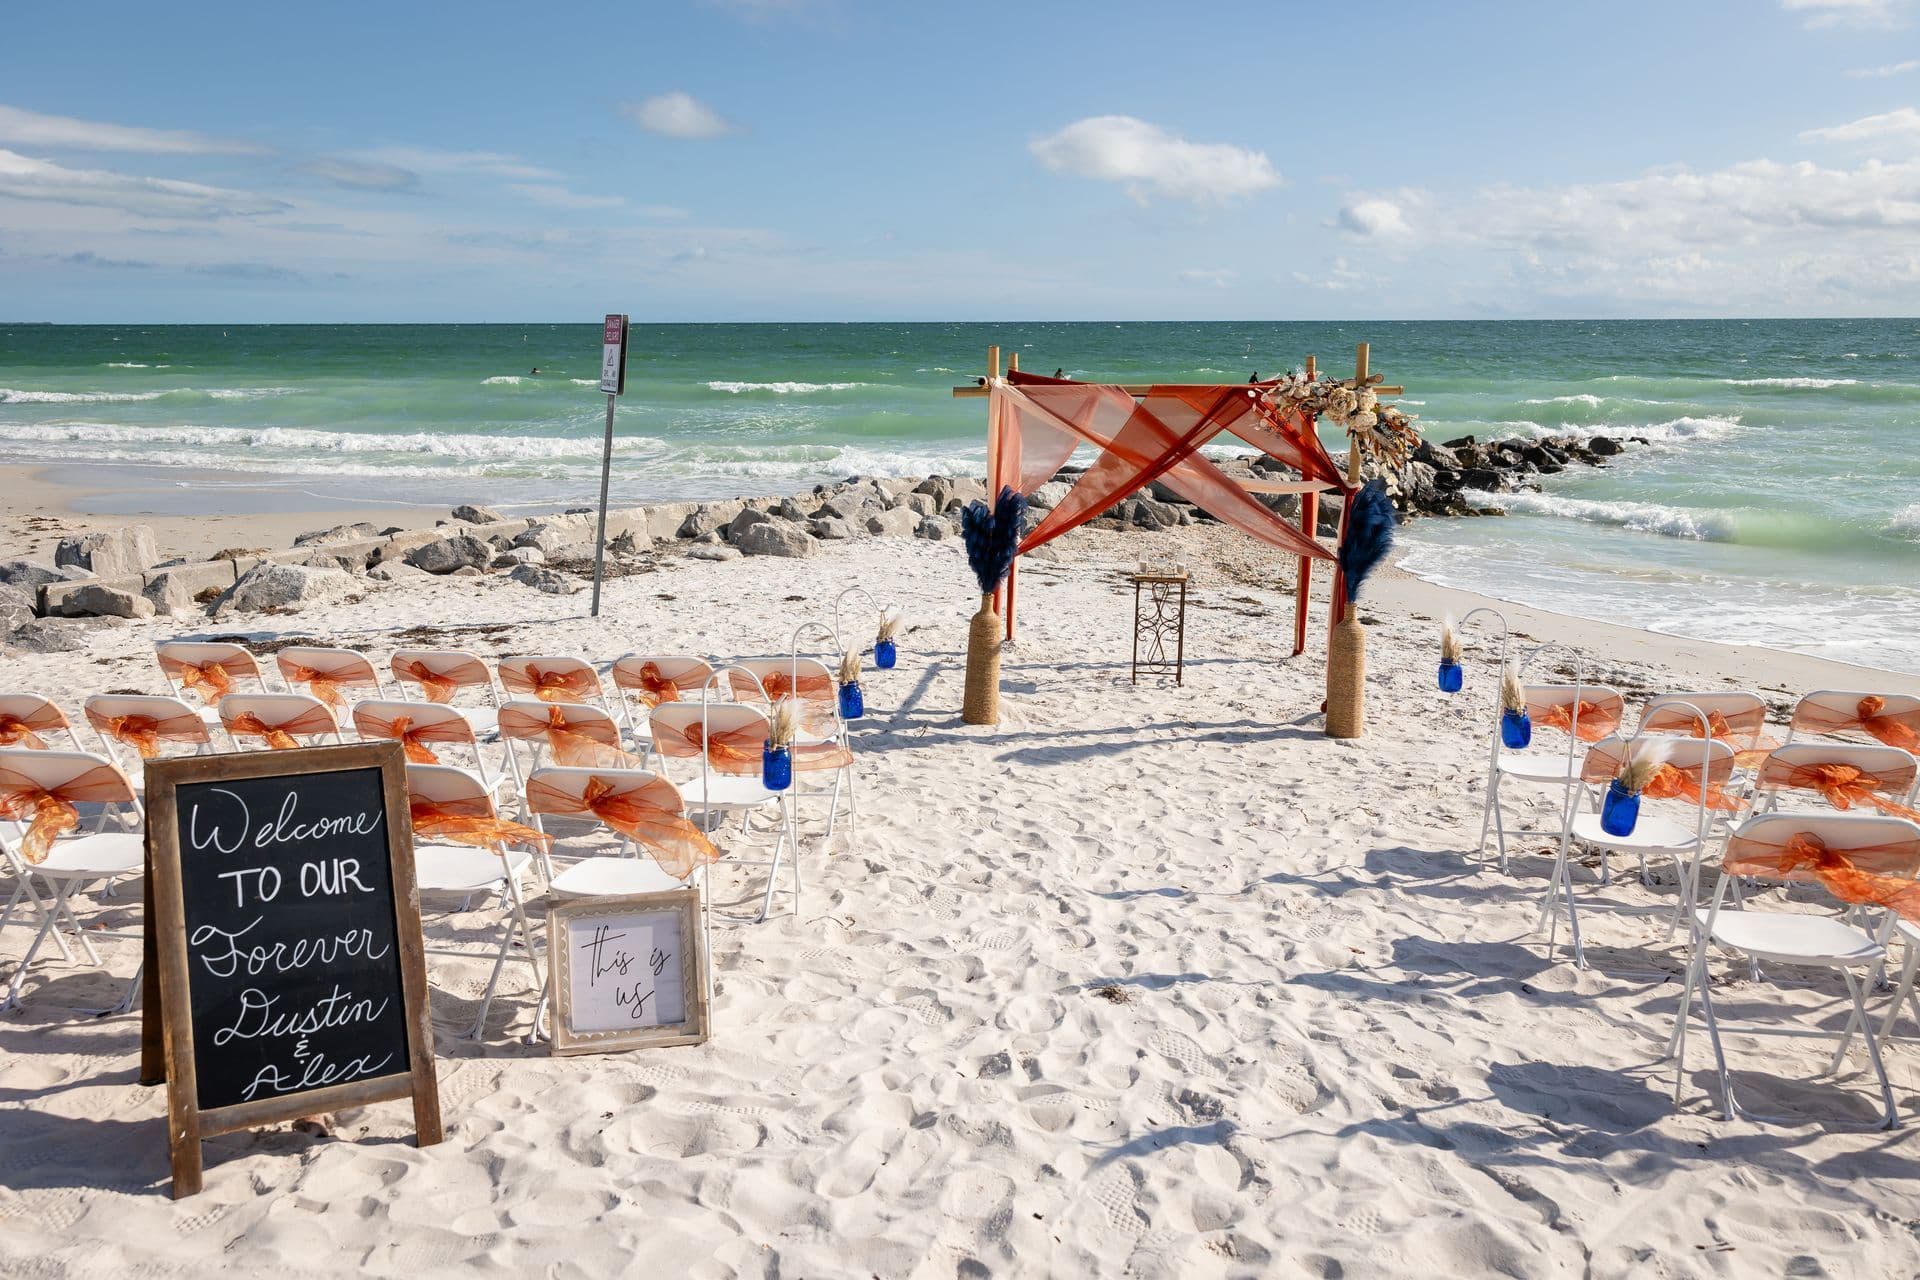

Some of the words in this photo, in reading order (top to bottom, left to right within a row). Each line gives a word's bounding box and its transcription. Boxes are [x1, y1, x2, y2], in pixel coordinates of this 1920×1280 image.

[190, 788, 383, 853] Welcome
[217, 866, 281, 907] TO
[300, 857, 376, 897] OUR
[191, 915, 390, 978] Forever
[650, 947, 671, 976] is
[214, 984, 388, 1045] Dustin
[616, 982, 655, 1019] us
[241, 1053, 392, 1101] Alex
